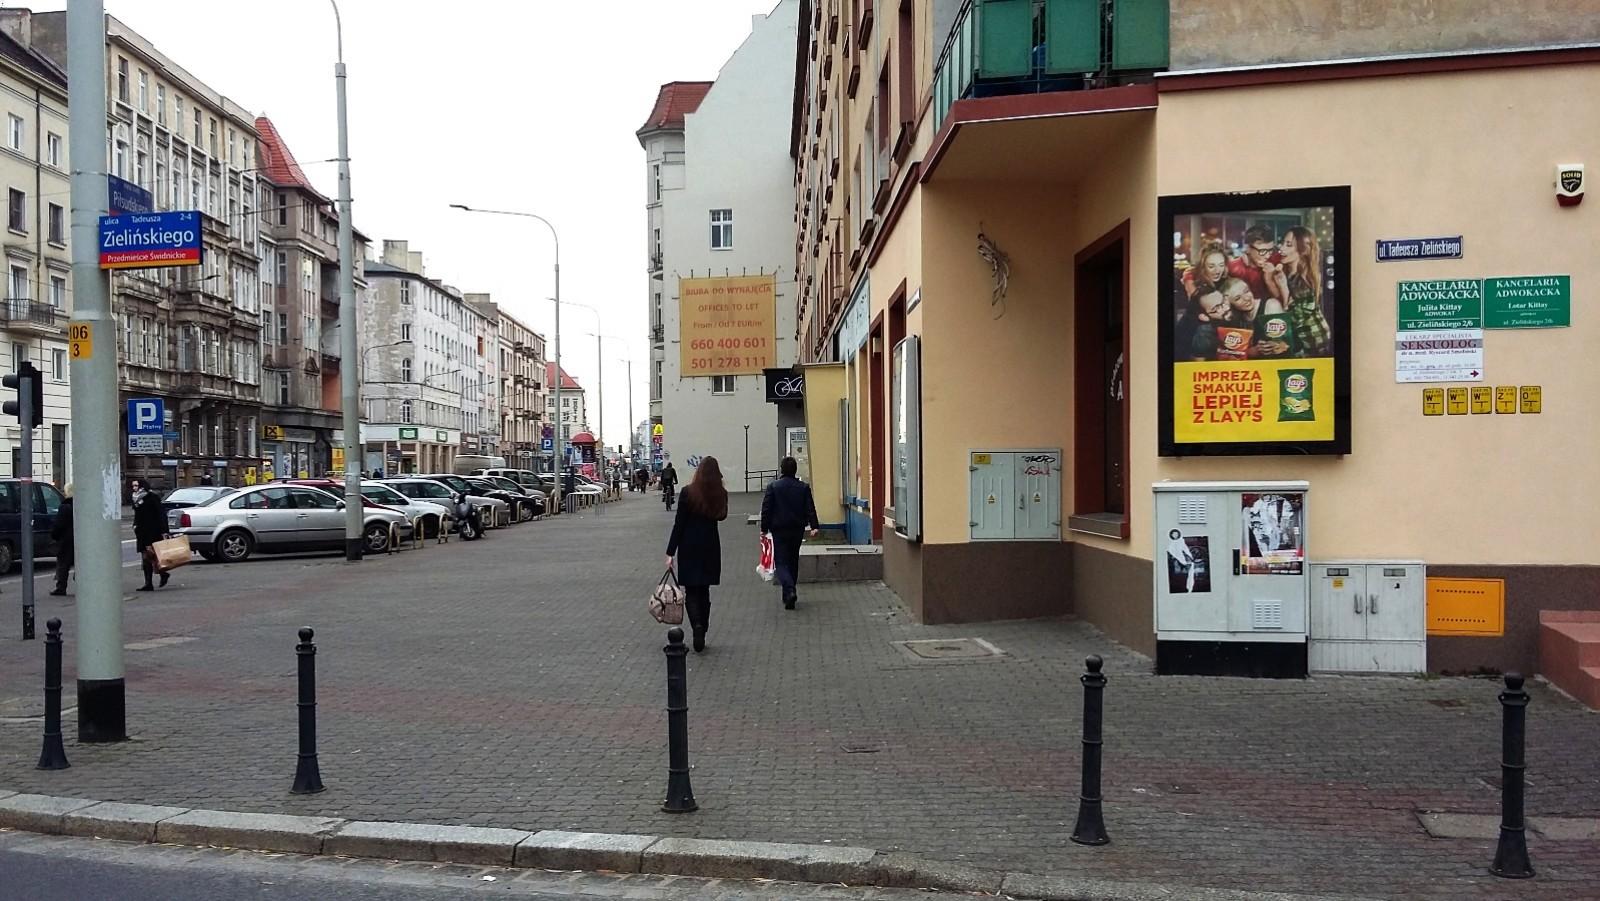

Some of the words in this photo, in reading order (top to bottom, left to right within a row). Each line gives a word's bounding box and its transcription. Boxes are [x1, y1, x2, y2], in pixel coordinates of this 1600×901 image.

[131, 215, 161, 223] Tadeusza
[103, 227, 194, 248] Zielińskiego
[1389, 242, 1419, 256] Tadeusza
[1421, 240, 1460, 256] Zielińskiego
[107, 253, 149, 263] Przedmieście
[149, 251, 186, 260] Świdnickie
[1401, 280, 1478, 292] KANCELARIA
[1496, 278, 1560, 288] KANCELARIA
[686, 287, 709, 296] BIURA
[712, 287, 724, 295] DO
[1400, 290, 1480, 301] ADWOKACKA
[1495, 288, 1561, 297] ADWOKACKA
[698, 303, 728, 312] OFFICES
[732, 303, 742, 311] TO
[746, 303, 759, 311] LET
[1418, 304, 1438, 313] Julita
[718, 320, 729, 328] Od
[1417, 320, 1461, 329] Zielińskiego
[1463, 320, 1473, 328] 2/6
[691, 338, 713, 350] 660
[717, 338, 740, 349] 400
[743, 337, 766, 348] 601
[1401, 340, 1477, 350] SEKSUOLOG
[73, 343, 80, 357] 3
[691, 358, 713, 369] 501
[718, 357, 740, 368] 278
[745, 356, 766, 367] 111
[1192, 370, 1262, 382] IMPREZA
[1193, 382, 1262, 394] SMAKUJE
[1192, 394, 1263, 410] LEPIEJ
[136, 402, 156, 429] P
[1193, 411, 1204, 423] Z
[1210, 410, 1263, 423] LAY'S
[544, 440, 551, 449] P
